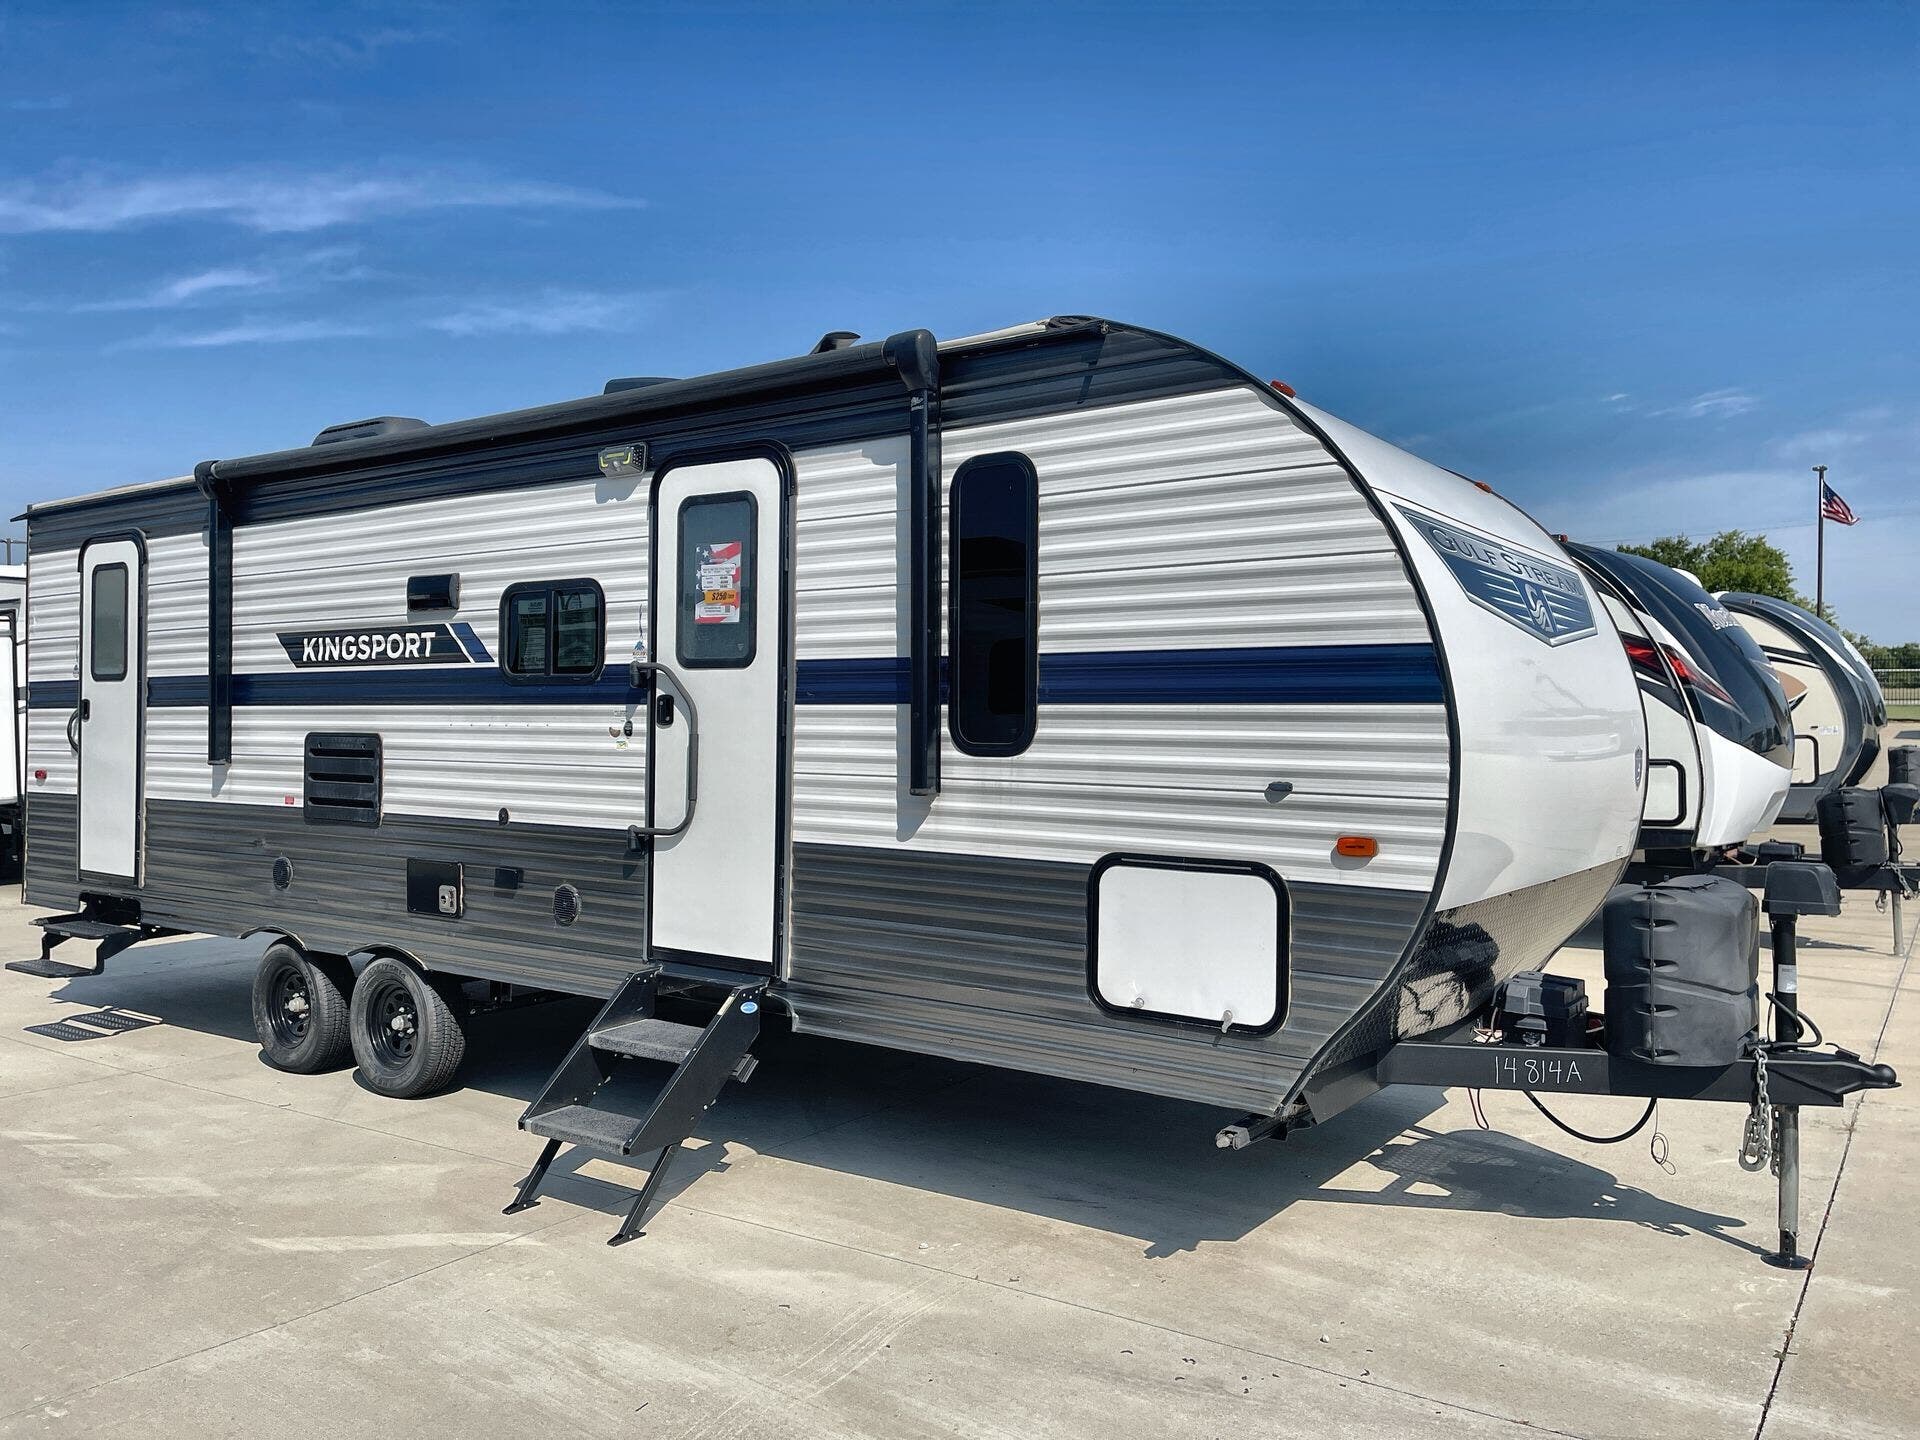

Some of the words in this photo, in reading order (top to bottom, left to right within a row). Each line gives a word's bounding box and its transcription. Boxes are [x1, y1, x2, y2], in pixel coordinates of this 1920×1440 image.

[1430, 528, 1498, 566] GULF
[1500, 551, 1584, 597] STREAM
[302, 631, 436, 662] KINGSPORT
[1495, 1055, 1583, 1084] 14814A
